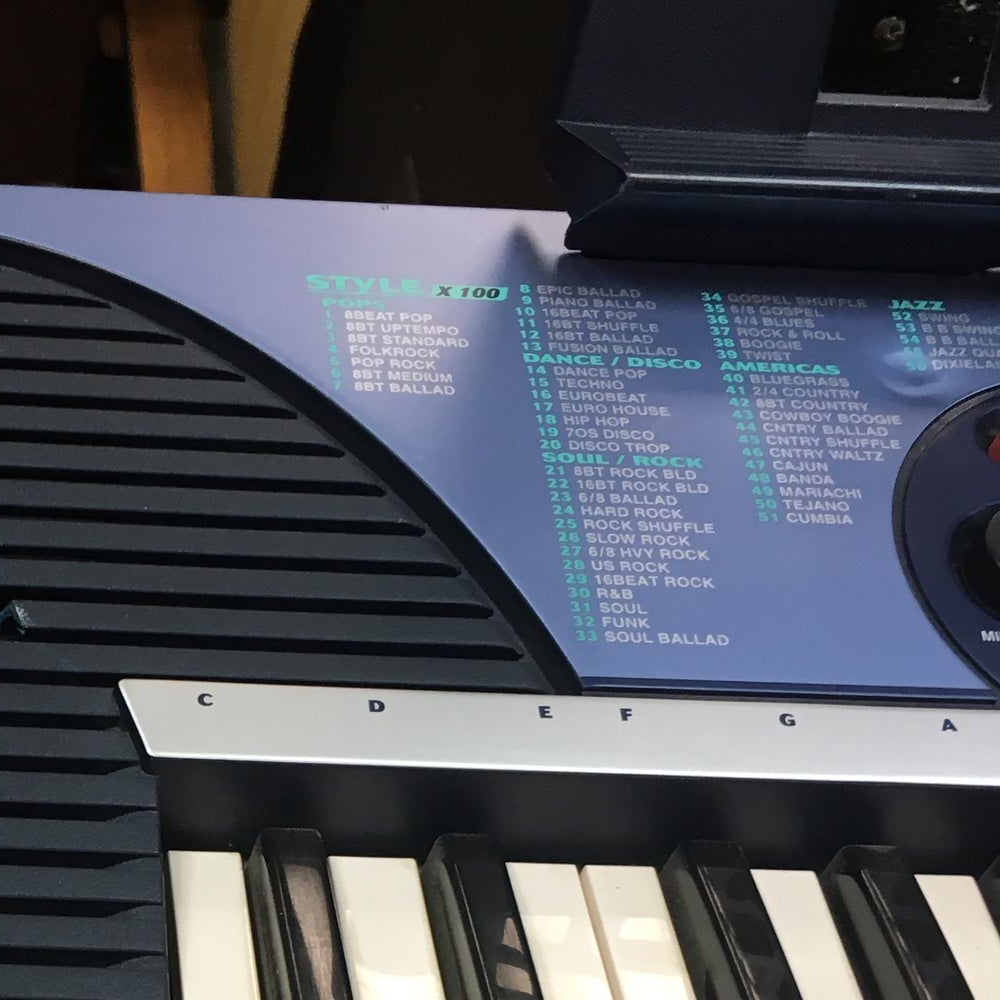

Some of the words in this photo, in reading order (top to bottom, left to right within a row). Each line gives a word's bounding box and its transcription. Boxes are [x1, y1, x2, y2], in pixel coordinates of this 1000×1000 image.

[306, 274, 422, 295] STYLE
[537, 286, 572, 295] EPIC
[578, 287, 640, 298] BALLAD
[701, 293, 722, 301] 34
[522, 296, 532, 304] 9
[540, 297, 589, 307] PIANO
[593, 299, 656, 310] BALLAD
[889, 299, 945, 311] JAZZ
[345, 311, 394, 321] 8BEAT
[400, 313, 432, 323] POP
[516, 307, 535, 316] 10
[543, 308, 599, 318] 16BEAT
[605, 311, 636, 320] POP
[704, 304, 725, 313] 35
[759, 306, 824, 317] GOSPEL
[518, 319, 535, 327] 11
[545, 320, 582, 330] 16BT
[587, 321, 659, 332] SHUFFLE
[707, 315, 728, 324] 36
[734, 316, 757, 326] 4/4
[762, 318, 815, 328] BLUES
[346, 322, 375, 332] 8BT
[381, 323, 458, 335] UPTEMPO
[710, 327, 730, 336] 37
[737, 327, 782, 338] ROCK
[804, 331, 845, 341] ROLL
[348, 334, 376, 344] 8BT
[383, 335, 469, 348] STANDARD
[521, 331, 540, 339] 12
[547, 332, 584, 341] 16BT
[590, 333, 653, 344] BALLAD
[713, 338, 735, 347] 38
[740, 339, 802, 350] BOOGIE
[350, 346, 440, 358] FOLKROCK
[522, 342, 541, 350] 13
[549, 342, 608, 354] FUSION
[613, 345, 677, 356] BALLAD
[716, 350, 737, 359] 39
[743, 351, 791, 361] TWIST
[929, 347, 967, 356] JAZZ
[352, 357, 384, 367] POP
[390, 359, 436, 370] ROCK
[523, 353, 604, 365] DANCE
[628, 357, 701, 369] DISCO
[527, 366, 546, 374] 14
[554, 367, 609, 377] DANCE
[615, 368, 647, 379] POP
[720, 361, 840, 375] AMERICAS
[353, 370, 382, 379] 8BT
[388, 370, 452, 383] MEDIUM
[723, 373, 743, 383] 40
[750, 374, 850, 388] BLUEGRASS
[355, 382, 384, 392] 8BT
[390, 384, 455, 395] BALLAD
[529, 378, 549, 387] 15
[557, 379, 624, 390] TECHNO
[532, 390, 551, 399] 16
[559, 391, 647, 403] EUROBEAT
[727, 386, 744, 395] 41
[752, 386, 778, 396] 2/4
[783, 387, 860, 399] COUNTRY
[534, 403, 553, 411] 17
[561, 403, 607, 414] EURO
[613, 405, 670, 417] HOUSE
[756, 399, 786, 409] 8BT
[791, 400, 868, 412] COUNTRY
[536, 415, 556, 424] 18
[564, 415, 589, 425] HIP
[596, 417, 629, 426] HOP
[760, 410, 831, 422] COWBOY
[839, 413, 902, 425] BOOGIE
[539, 428, 559, 436] 19
[604, 429, 654, 440] DISCO
[762, 423, 816, 434] CNTRY
[822, 425, 888, 436] BALLAD
[540, 440, 561, 449] 20
[569, 440, 620, 452] DISCO
[625, 442, 670, 453] TROP
[766, 436, 820, 447] CNTRY
[826, 437, 901, 449] SHUFFLE
[542, 453, 609, 464] SOUL
[634, 456, 703, 468] ROCK
[769, 448, 823, 460] CNTRY
[831, 450, 884, 462] WALTZ
[546, 466, 564, 475] 21
[574, 466, 604, 477] 8BT
[610, 468, 658, 479] ROCK
[664, 470, 696, 480] BLD
[772, 460, 828, 473] CAJUN
[776, 474, 834, 485] BANDA
[548, 479, 569, 488] 22
[578, 480, 616, 490] 16BT
[622, 481, 670, 492] ROCK
[676, 483, 709, 494] BLD
[780, 486, 862, 500] MARIACHI
[550, 492, 570, 501] 23
[610, 494, 677, 505] BALLAD
[553, 505, 575, 515] 24
[581, 506, 628, 517] HARD
[634, 507, 683, 519] ROCK
[756, 499, 776, 509] 50
[783, 500, 849, 512] TEJANO
[759, 512, 778, 522] 51
[787, 513, 852, 526] CUMBIA
[555, 519, 576, 528] 25
[584, 519, 633, 531] ROCK
[639, 521, 715, 534] SHUFFLE
[558, 532, 579, 542] 26
[586, 533, 635, 544] SLOW
[641, 534, 690, 546] ROCK
[561, 546, 581, 555] 27
[620, 548, 653, 558] HVY
[660, 549, 709, 560] ROCK
[564, 560, 584, 570] 28
[591, 561, 614, 571] US
[620, 562, 670, 573] ROCK
[566, 574, 587, 584] 29
[595, 575, 658, 586] 16BEAT
[665, 577, 715, 588] ROCK
[568, 588, 590, 598] 30
[597, 589, 633, 600] R&B
[571, 602, 590, 612] 31
[600, 603, 647, 614] SOUL
[574, 616, 595, 627] 32
[602, 617, 650, 628] FUNK
[605, 631, 653, 643] SOUL
[659, 633, 729, 646] BALLAD
[199, 693, 213, 706] C
[369, 700, 385, 713] D
[539, 706, 552, 719] E
[620, 709, 632, 722] F
[779, 713, 796, 727] G
[942, 719, 958, 731] A
